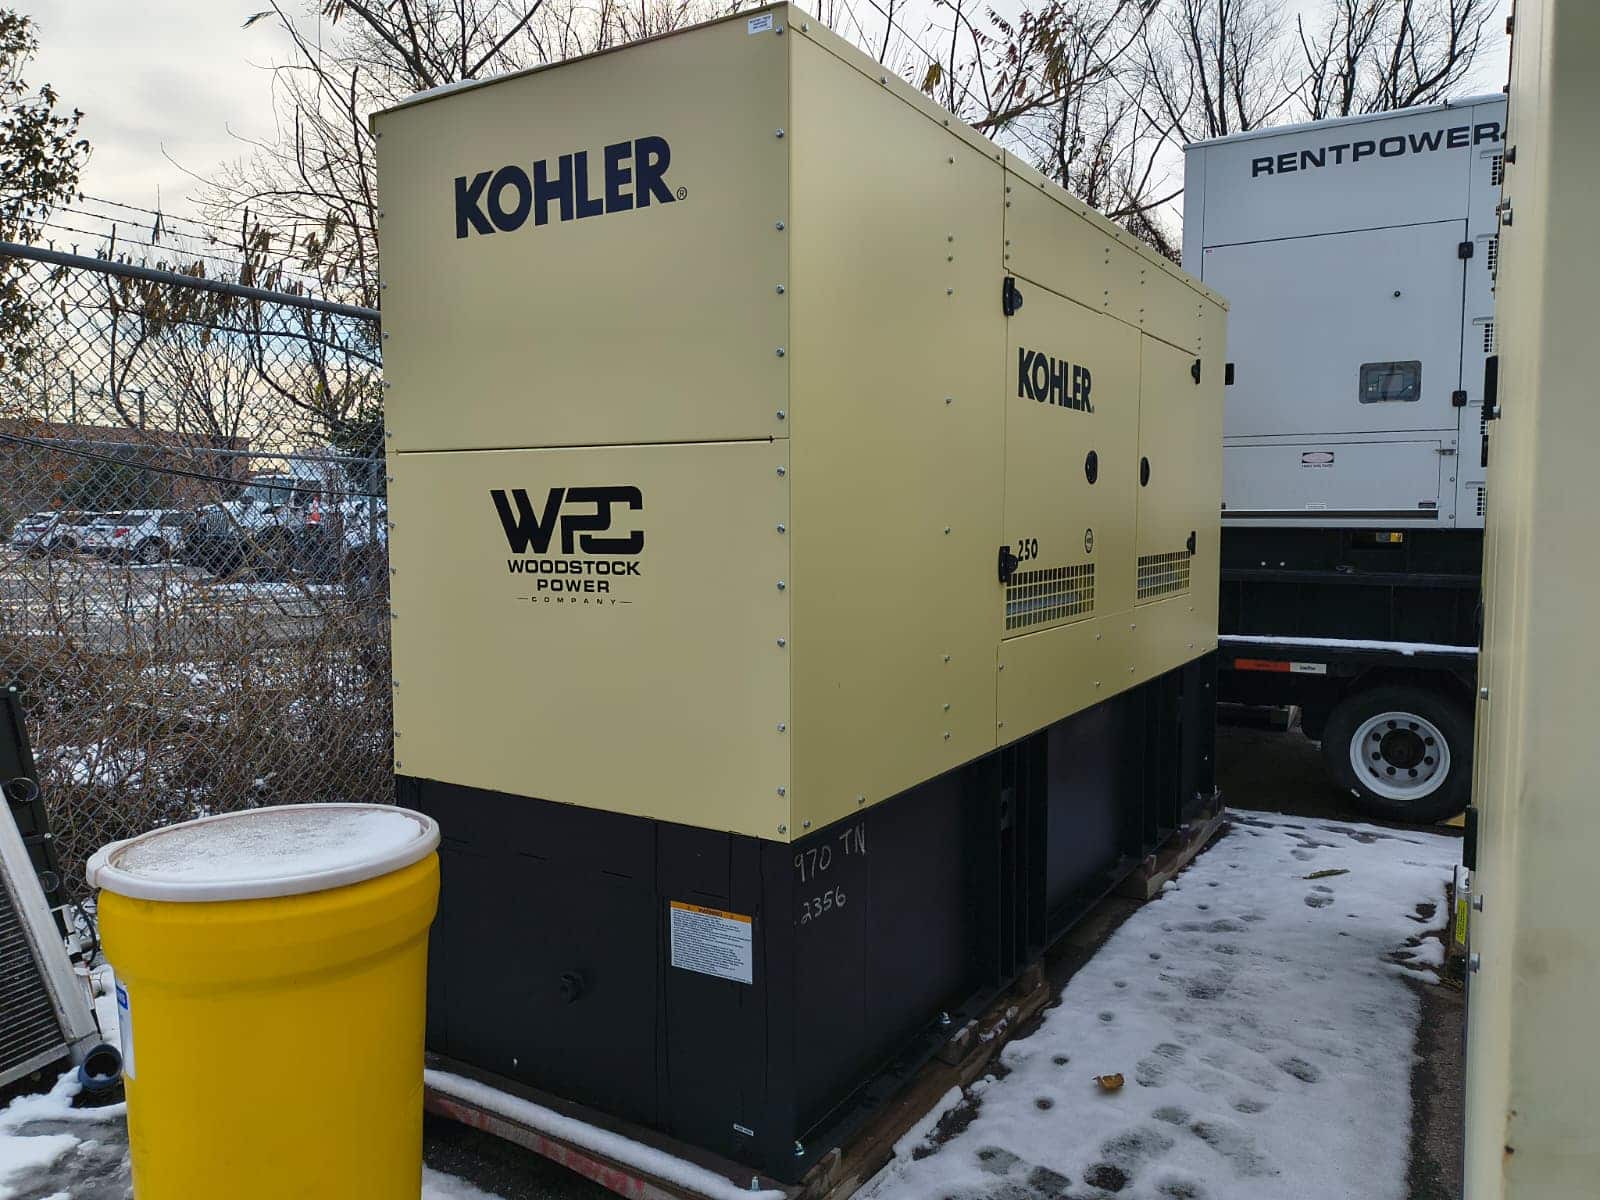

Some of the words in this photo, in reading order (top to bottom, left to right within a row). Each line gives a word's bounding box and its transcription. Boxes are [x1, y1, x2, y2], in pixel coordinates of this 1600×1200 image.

[454, 136, 677, 240] KOHLER
[1018, 347, 1092, 413] KOHLER
[490, 486, 645, 555] WPC
[1018, 538, 1039, 562] 250
[507, 559, 641, 576] WOODSTOCK
[531, 596, 616, 606] COMPANY
[537, 578, 610, 593] POWER
[801, 885, 847, 925] 2356
